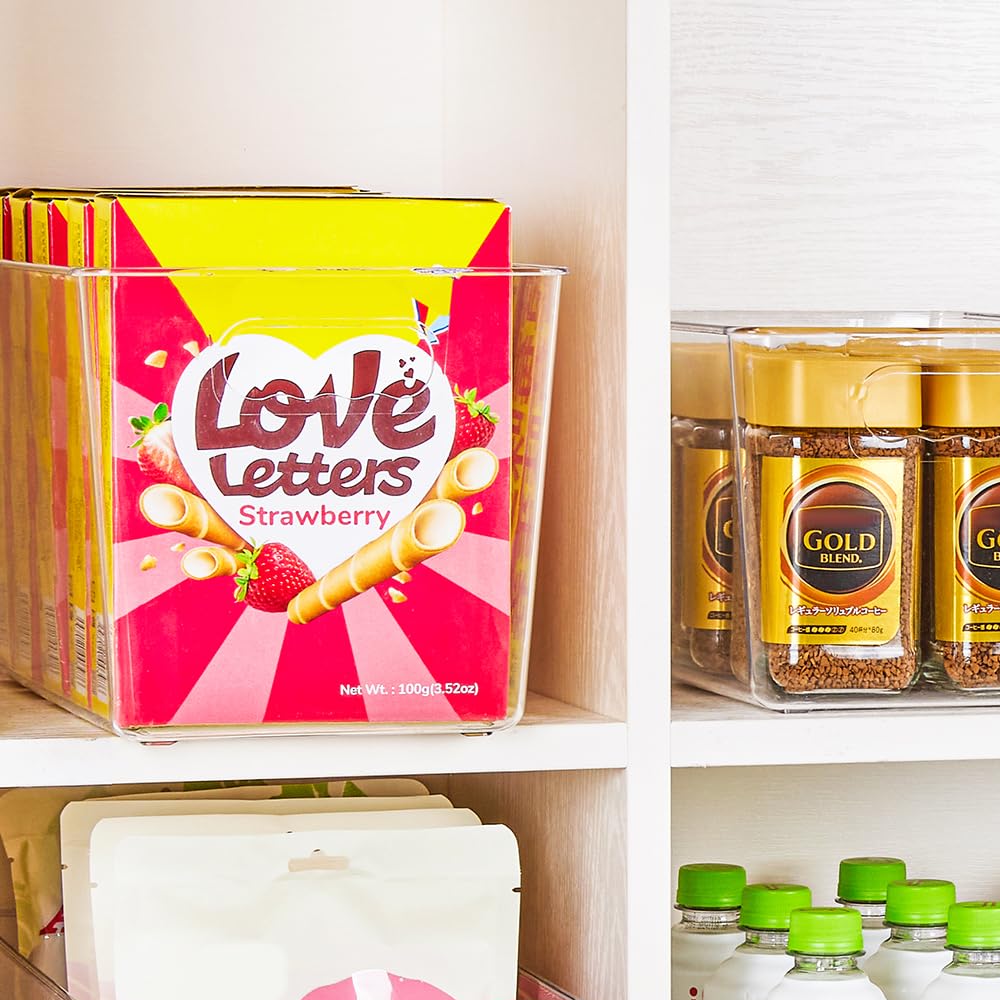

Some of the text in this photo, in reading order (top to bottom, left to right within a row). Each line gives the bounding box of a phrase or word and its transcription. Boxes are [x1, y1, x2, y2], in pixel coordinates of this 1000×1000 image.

[197, 350, 436, 451] Love
[209, 452, 420, 497] Letters
[239, 504, 391, 528] Strawberry
[803, 529, 876, 552] GOLD
[820, 552, 863, 564] BLEND.
[340, 682, 479, 697] Net Wt. 100g(3.52oz)
